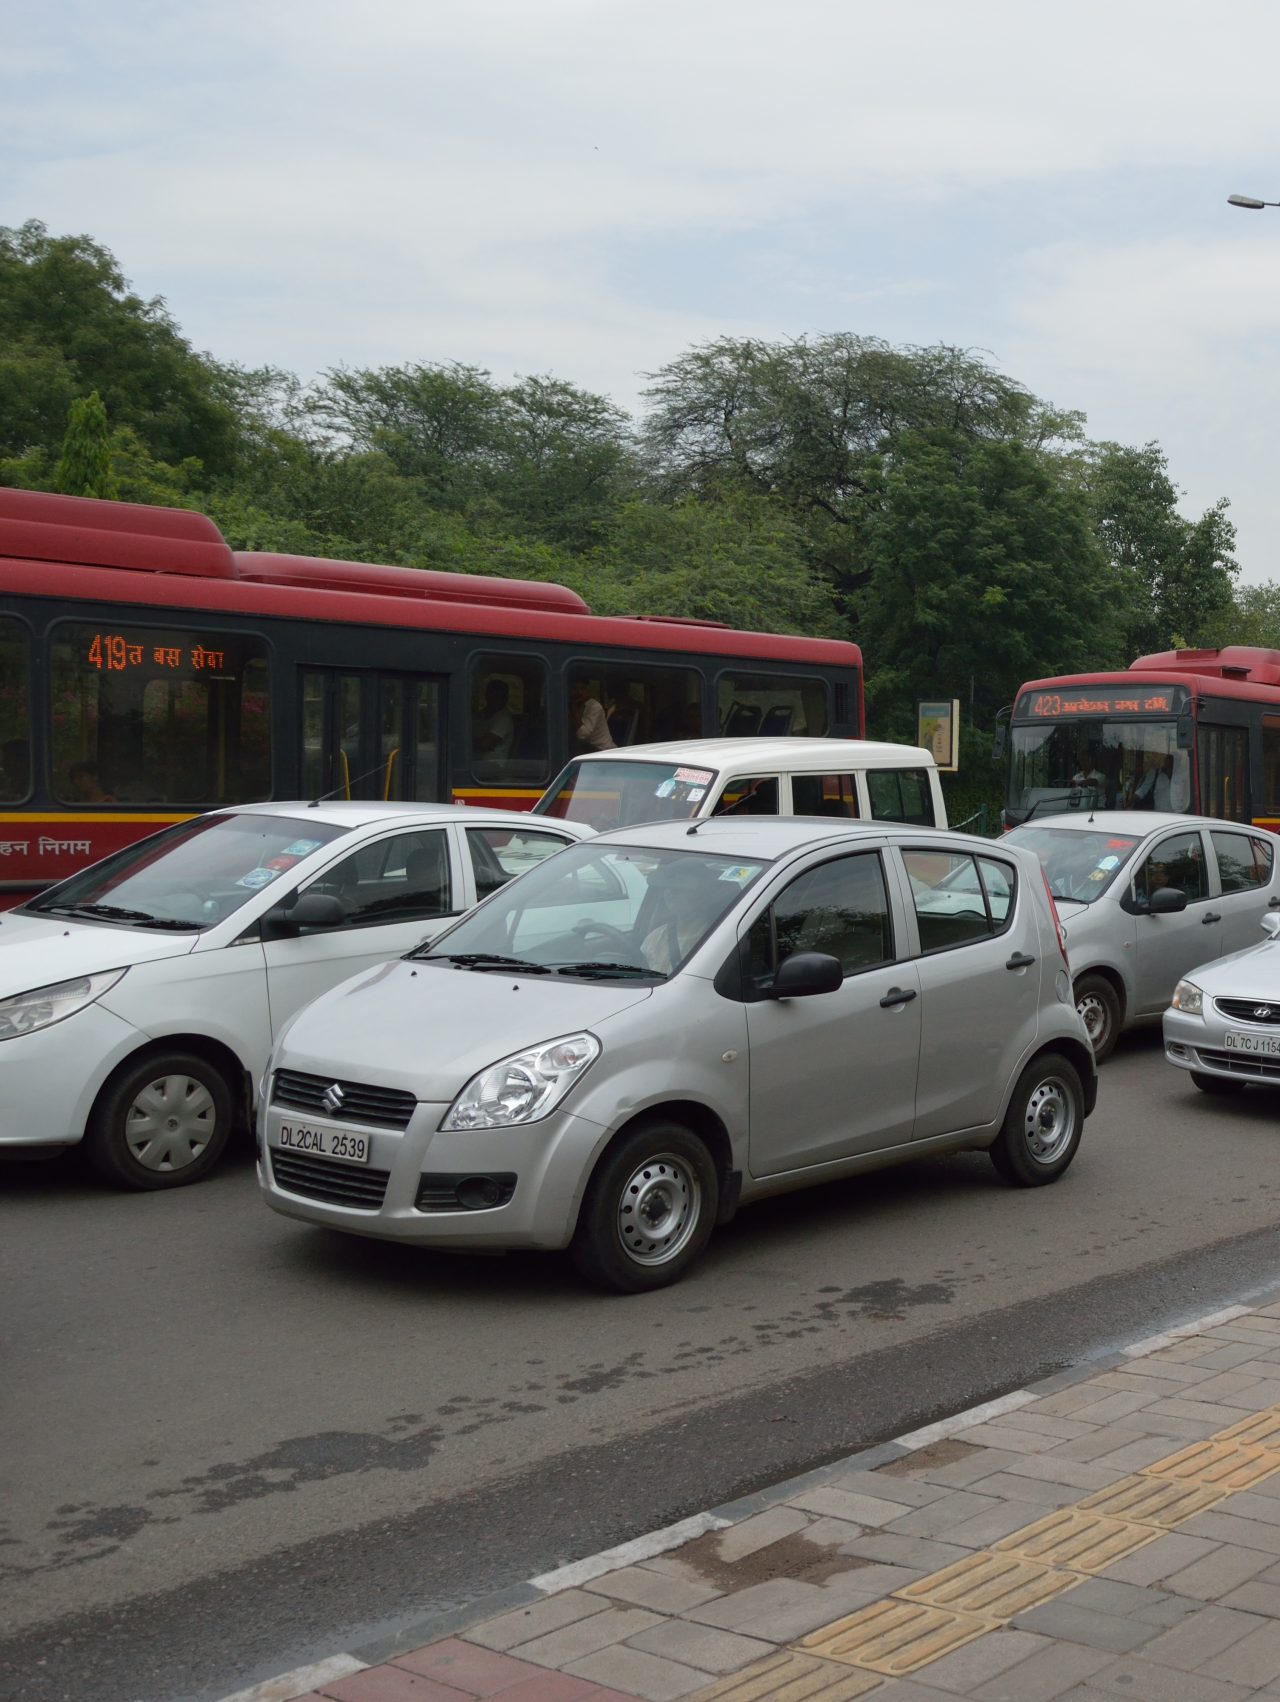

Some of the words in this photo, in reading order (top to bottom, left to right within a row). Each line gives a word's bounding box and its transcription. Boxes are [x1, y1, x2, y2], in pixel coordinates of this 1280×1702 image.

[153, 647, 181, 667] बस
[191, 644, 224, 669] सेवा
[1035, 695, 1061, 716] 423
[38, 835, 92, 856] निगम
[281, 1126, 327, 1153] DL2CAL
[331, 1134, 365, 1159] 2539
